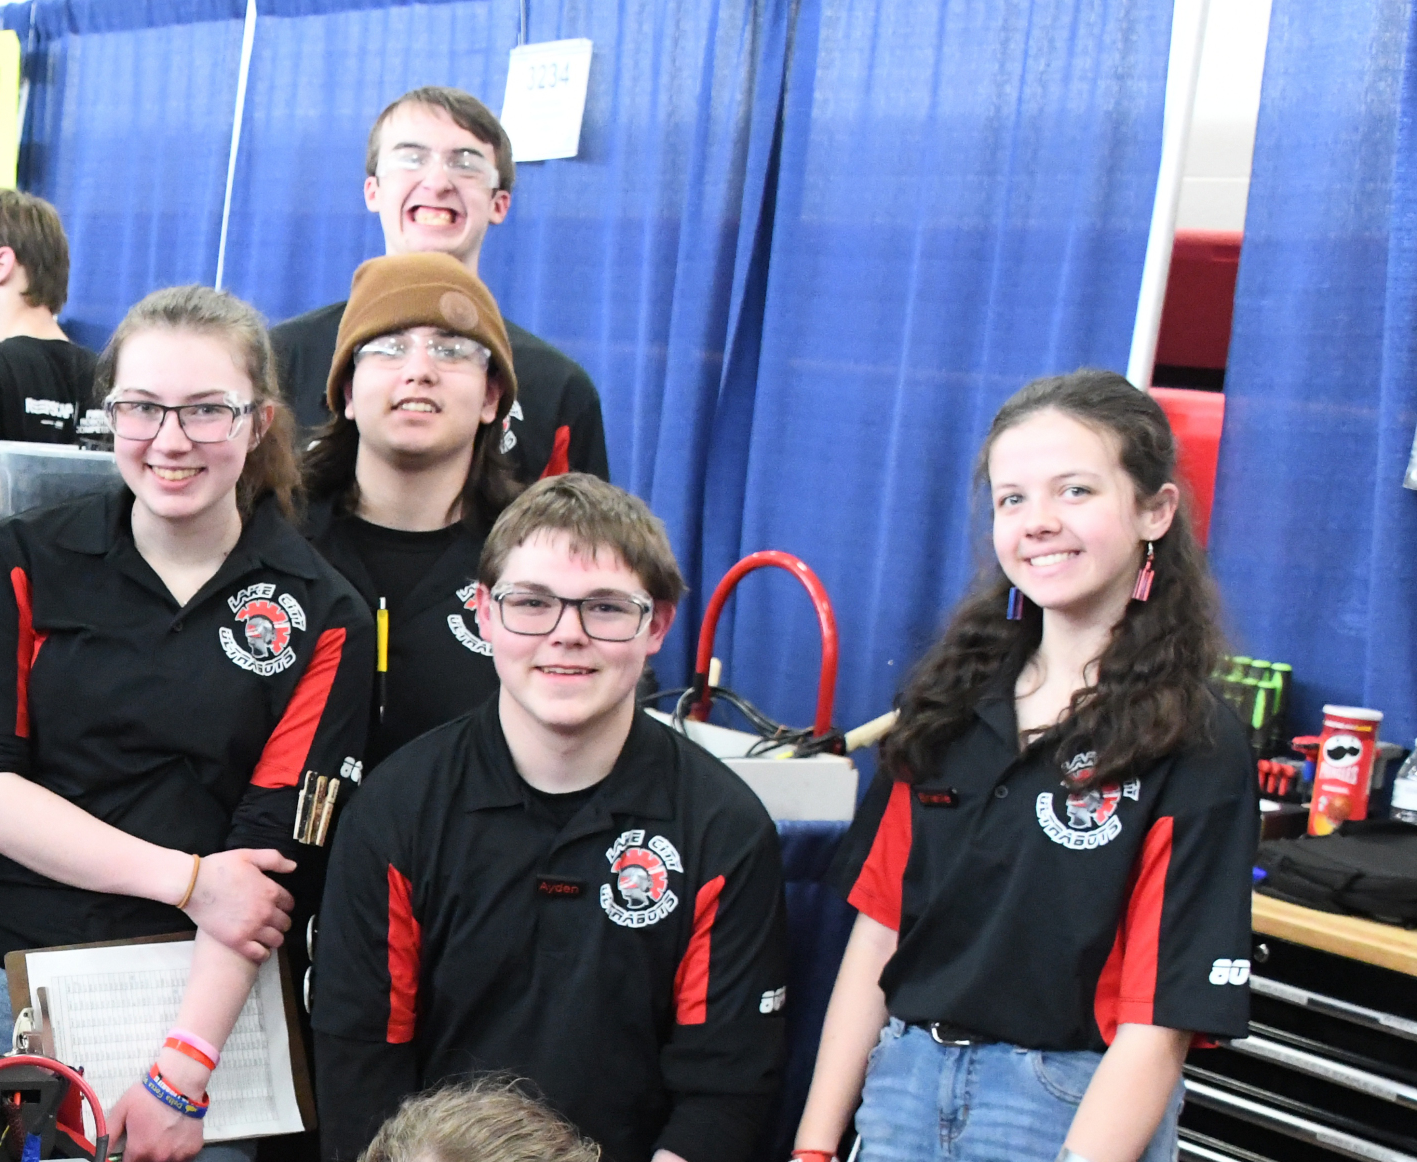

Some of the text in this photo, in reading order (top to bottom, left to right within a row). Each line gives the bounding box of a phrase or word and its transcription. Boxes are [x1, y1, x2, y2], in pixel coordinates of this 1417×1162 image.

[526, 61, 570, 90] 3234
[227, 583, 276, 613] LAKE
[539, 881, 580, 895] Ayden
